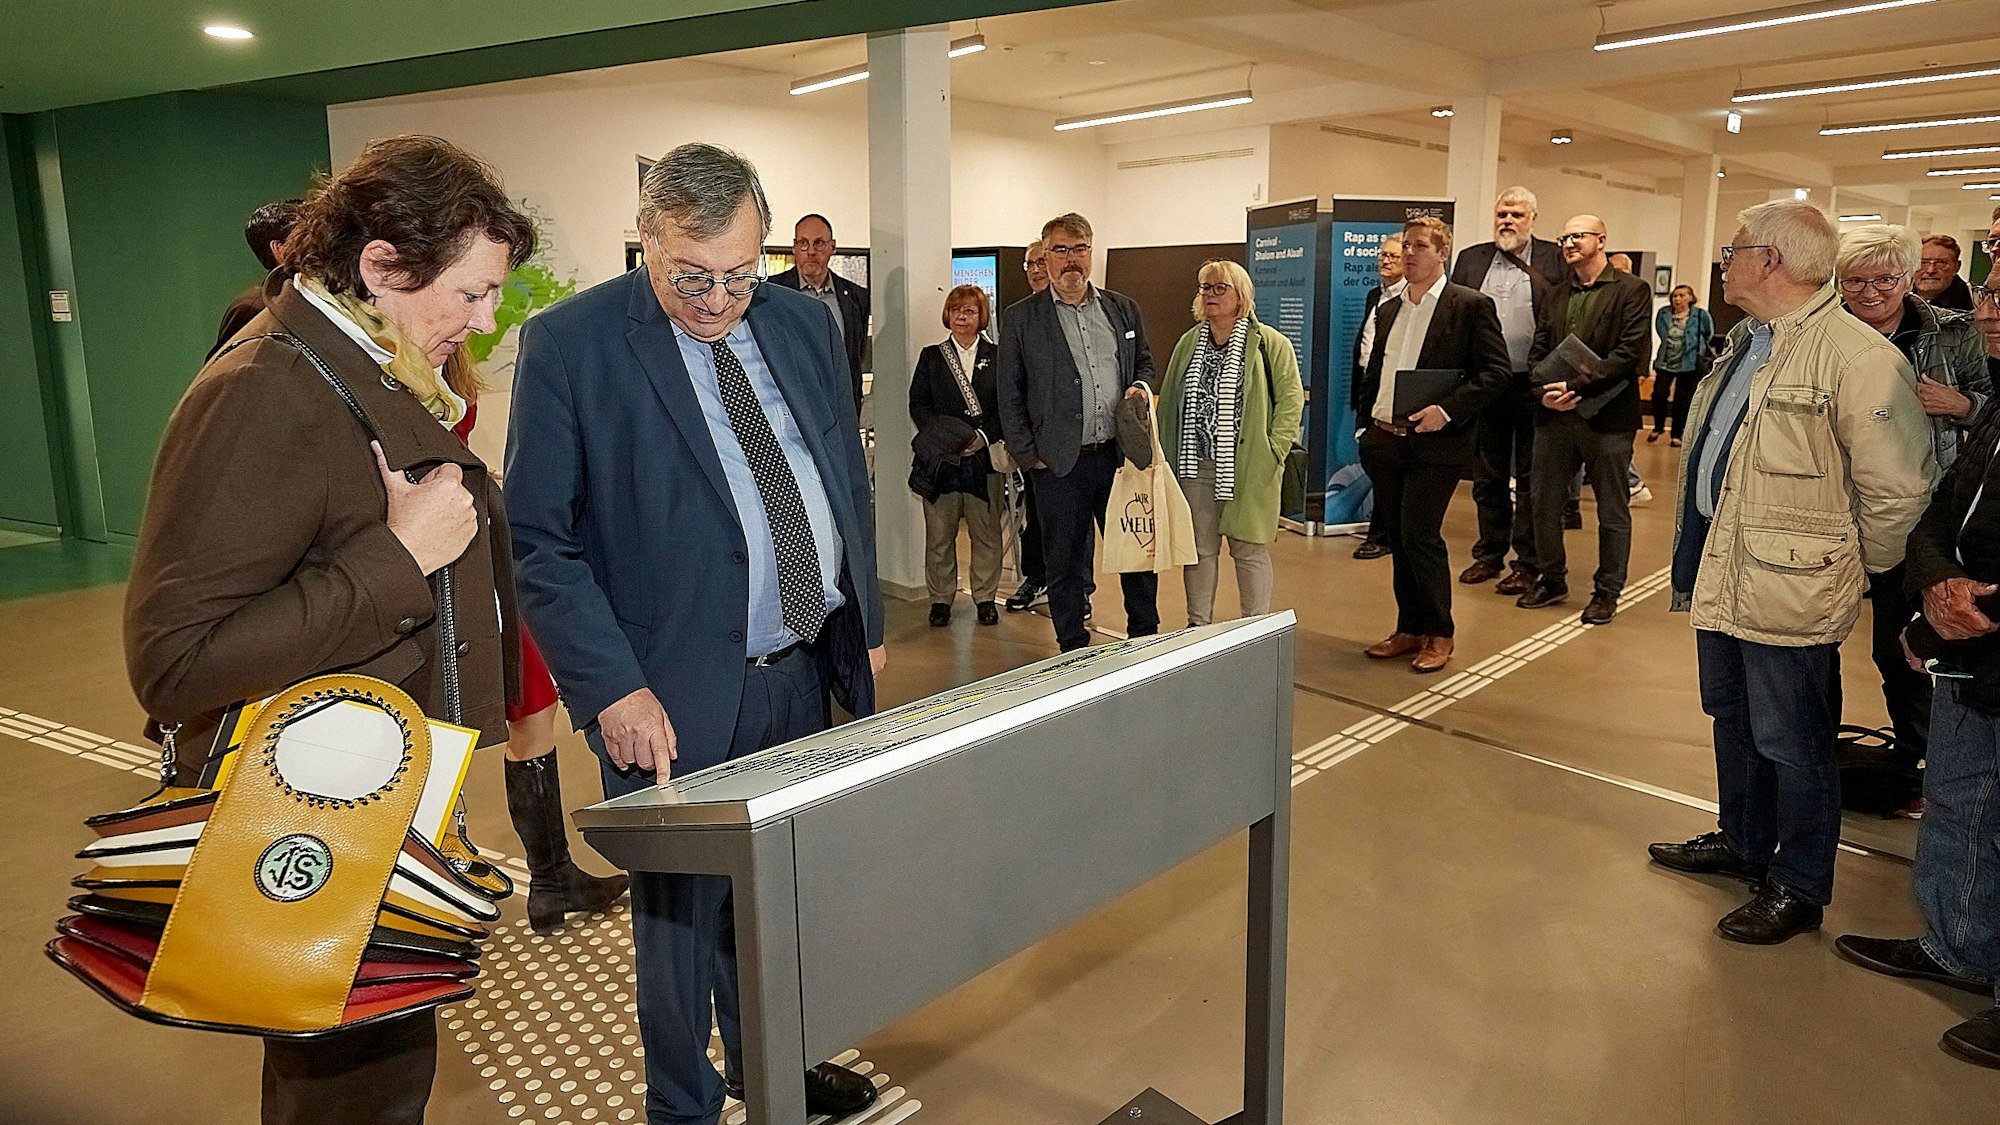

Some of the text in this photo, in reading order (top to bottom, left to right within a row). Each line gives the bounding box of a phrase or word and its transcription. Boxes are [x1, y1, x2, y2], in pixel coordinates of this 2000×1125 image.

[1255, 237, 1277, 248] Carnival
[1344, 232, 1365, 244] Rap
[1366, 234, 1379, 243] as
[1255, 250, 1275, 261] Shalom
[1276, 249, 1286, 259] and
[1343, 246, 1355, 257] of
[1344, 262, 1379, 274] Rap als
[954, 278, 978, 286] BILDER
[1343, 276, 1359, 286] der
[1134, 492, 1149, 504] WIR
